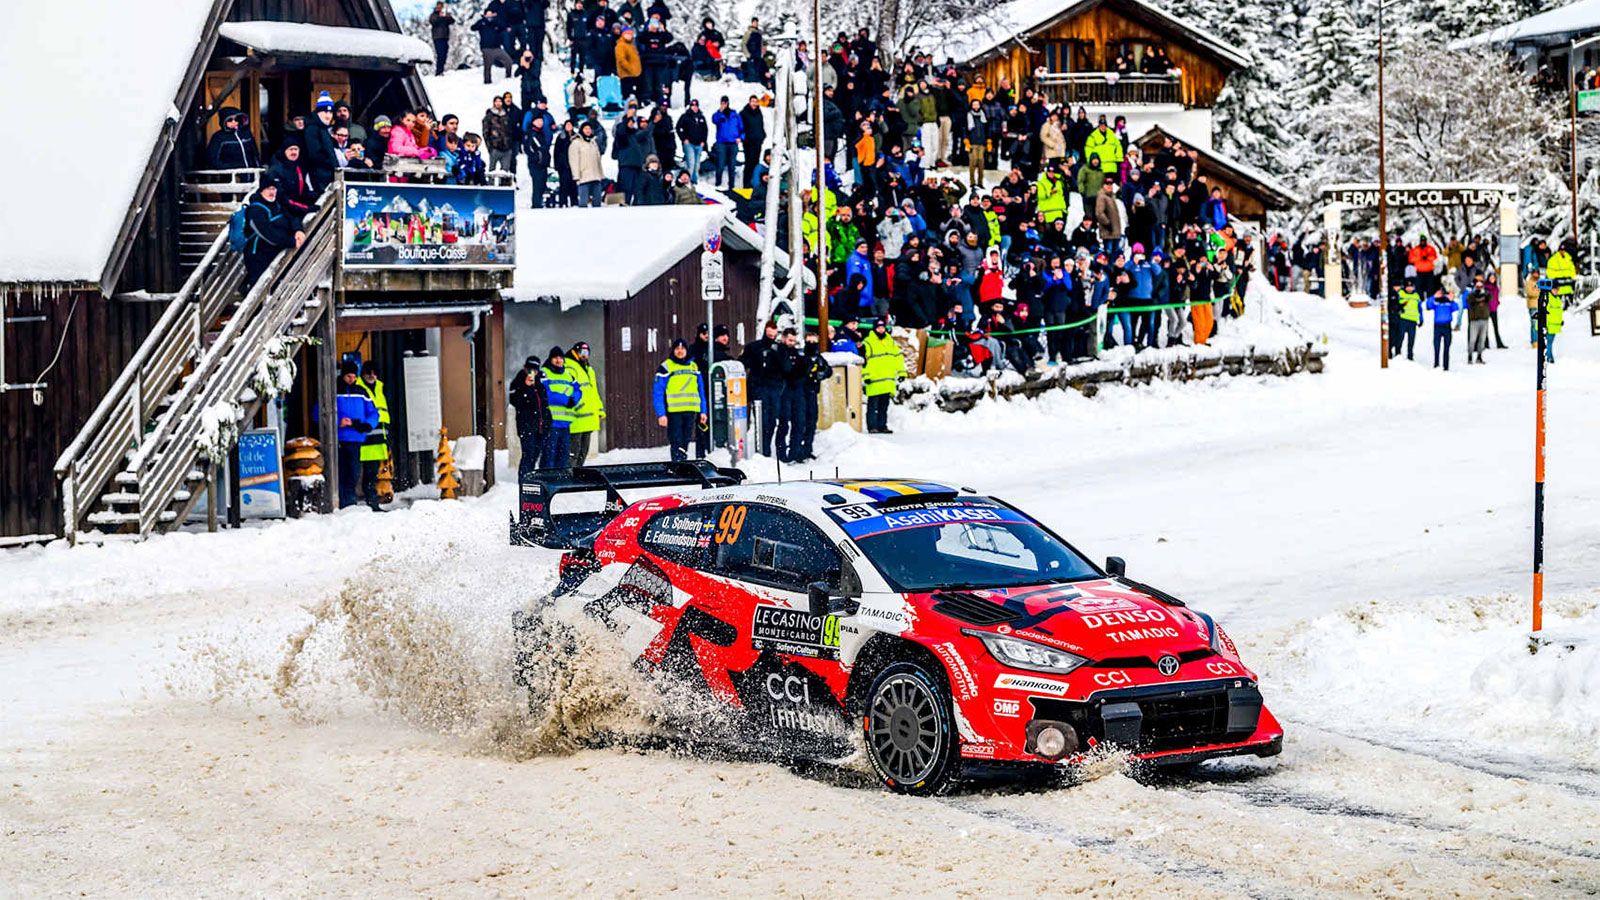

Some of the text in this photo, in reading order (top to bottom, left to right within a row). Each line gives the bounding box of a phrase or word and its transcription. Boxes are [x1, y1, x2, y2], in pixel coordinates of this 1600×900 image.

[1416, 190, 1450, 205] COL
[398, 245, 467, 261] Boutique-Caisse
[842, 506, 872, 519] 99
[876, 502, 924, 513] TOYOTA
[671, 516, 703, 534] Solberg
[714, 504, 747, 544] 99
[884, 509, 1002, 528] AsahiKASEI
[652, 531, 697, 548] Edmondson
[756, 608, 821, 631] LE CASINO
[861, 606, 903, 622] TAMADIC
[1081, 609, 1165, 629] DENSO
[841, 625, 859, 635] PIAA
[1106, 627, 1179, 643] TAMADIC
[1015, 629, 1081, 652] codebeamer
[931, 643, 971, 701] AUTOMOTIVE
[942, 641, 978, 697] Panasonic
[993, 702, 1020, 715] OMP
